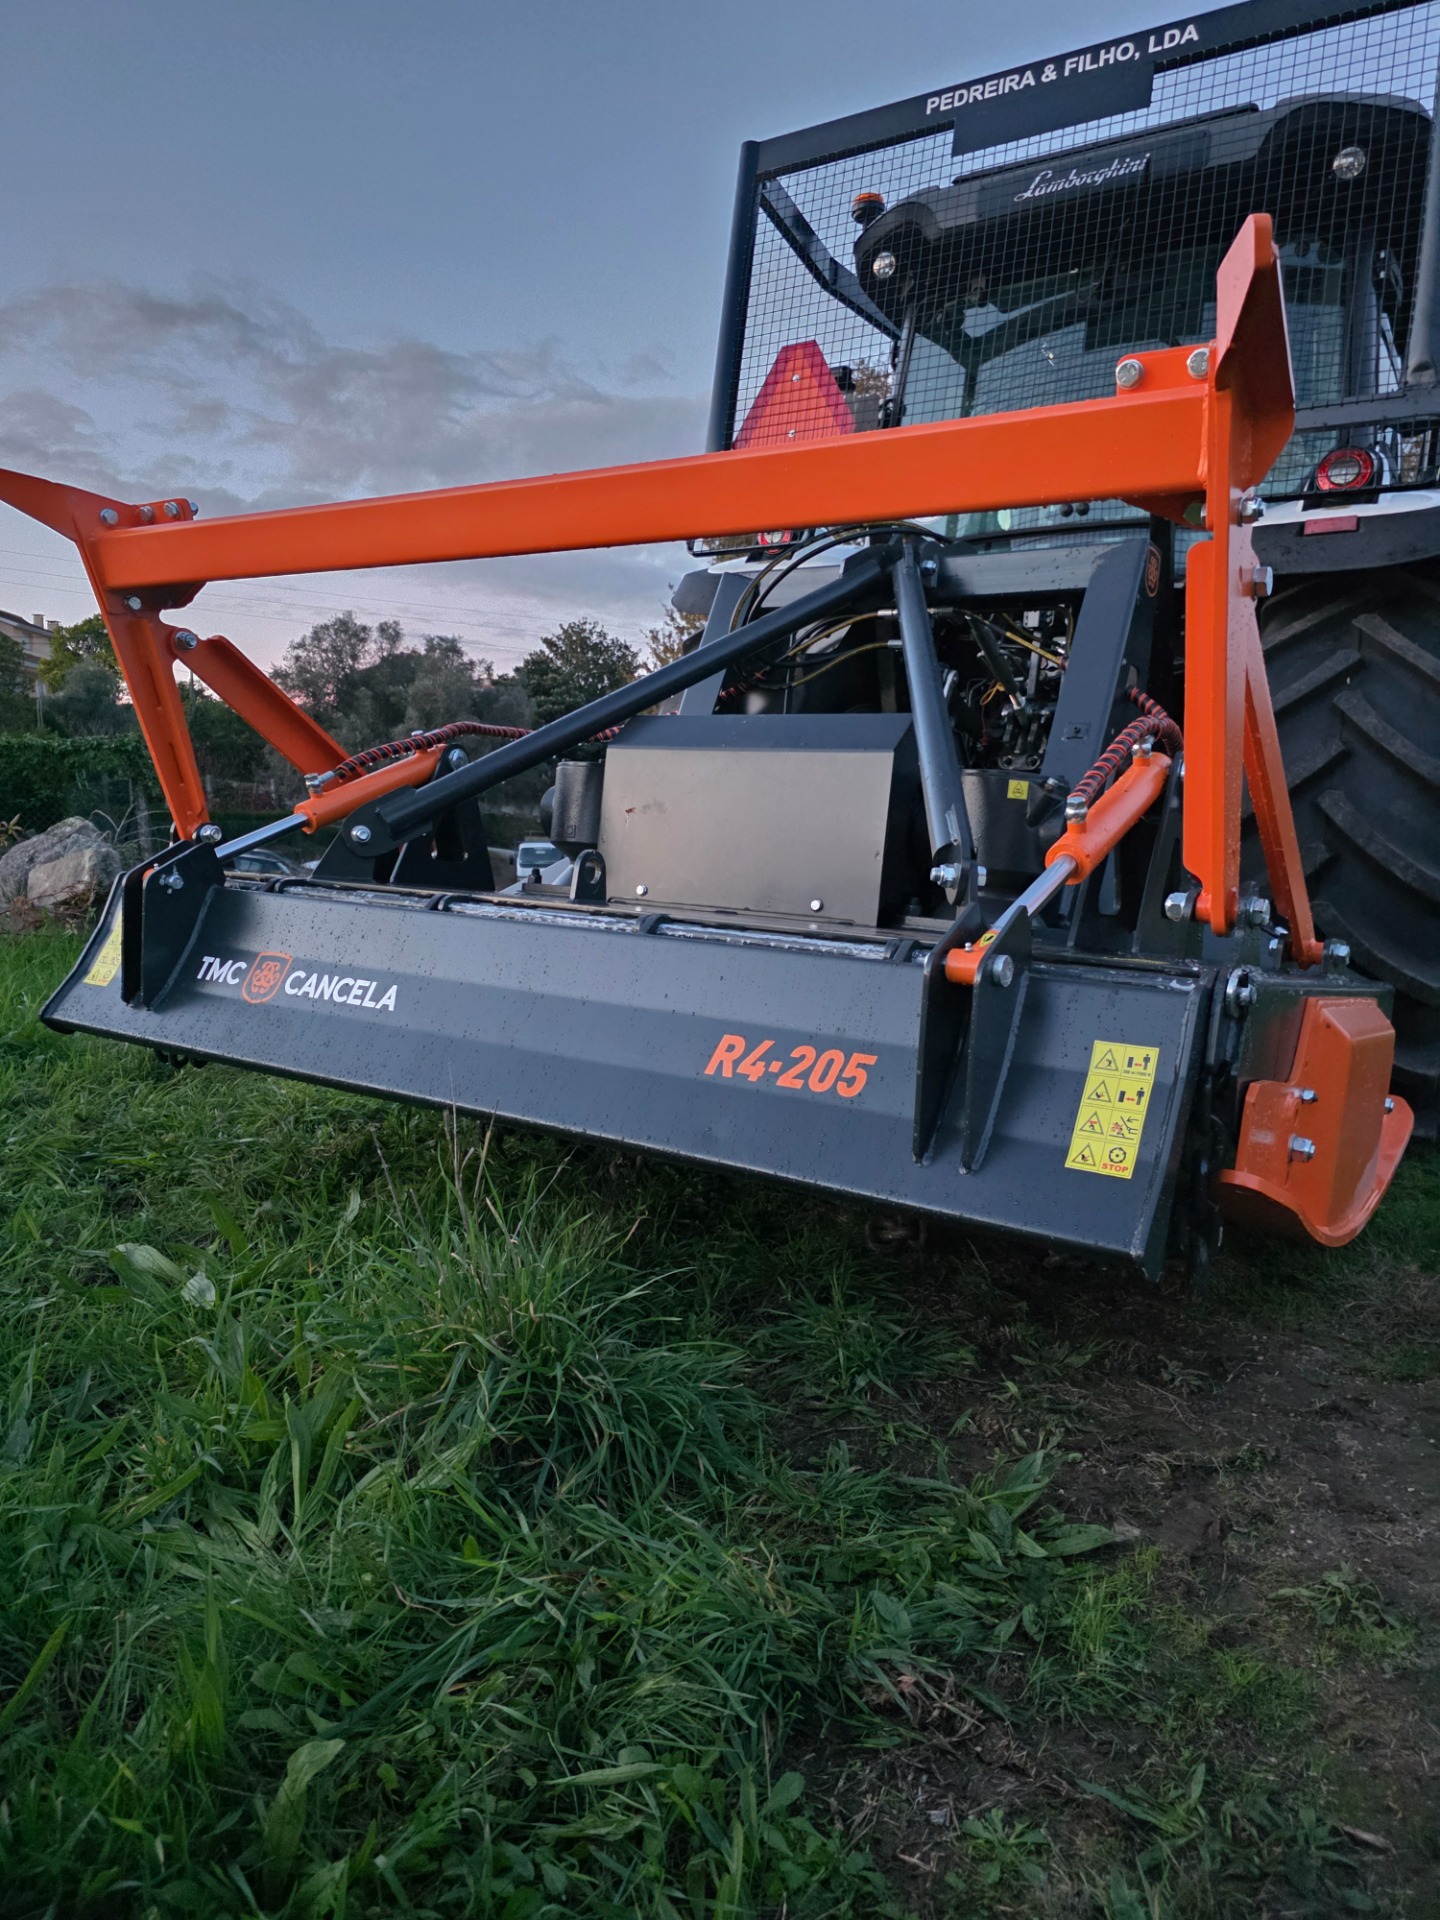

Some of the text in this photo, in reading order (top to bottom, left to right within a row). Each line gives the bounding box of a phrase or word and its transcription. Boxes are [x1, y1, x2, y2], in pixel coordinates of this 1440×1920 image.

[926, 24, 1199, 115] PEDREIRA & FILHO, LDA
[1014, 153, 1151, 202] Lamborghini
[197, 956, 398, 1011] TMC CANCELA
[704, 1034, 878, 1098] R4-205
[1102, 1162, 1129, 1173] STOP
